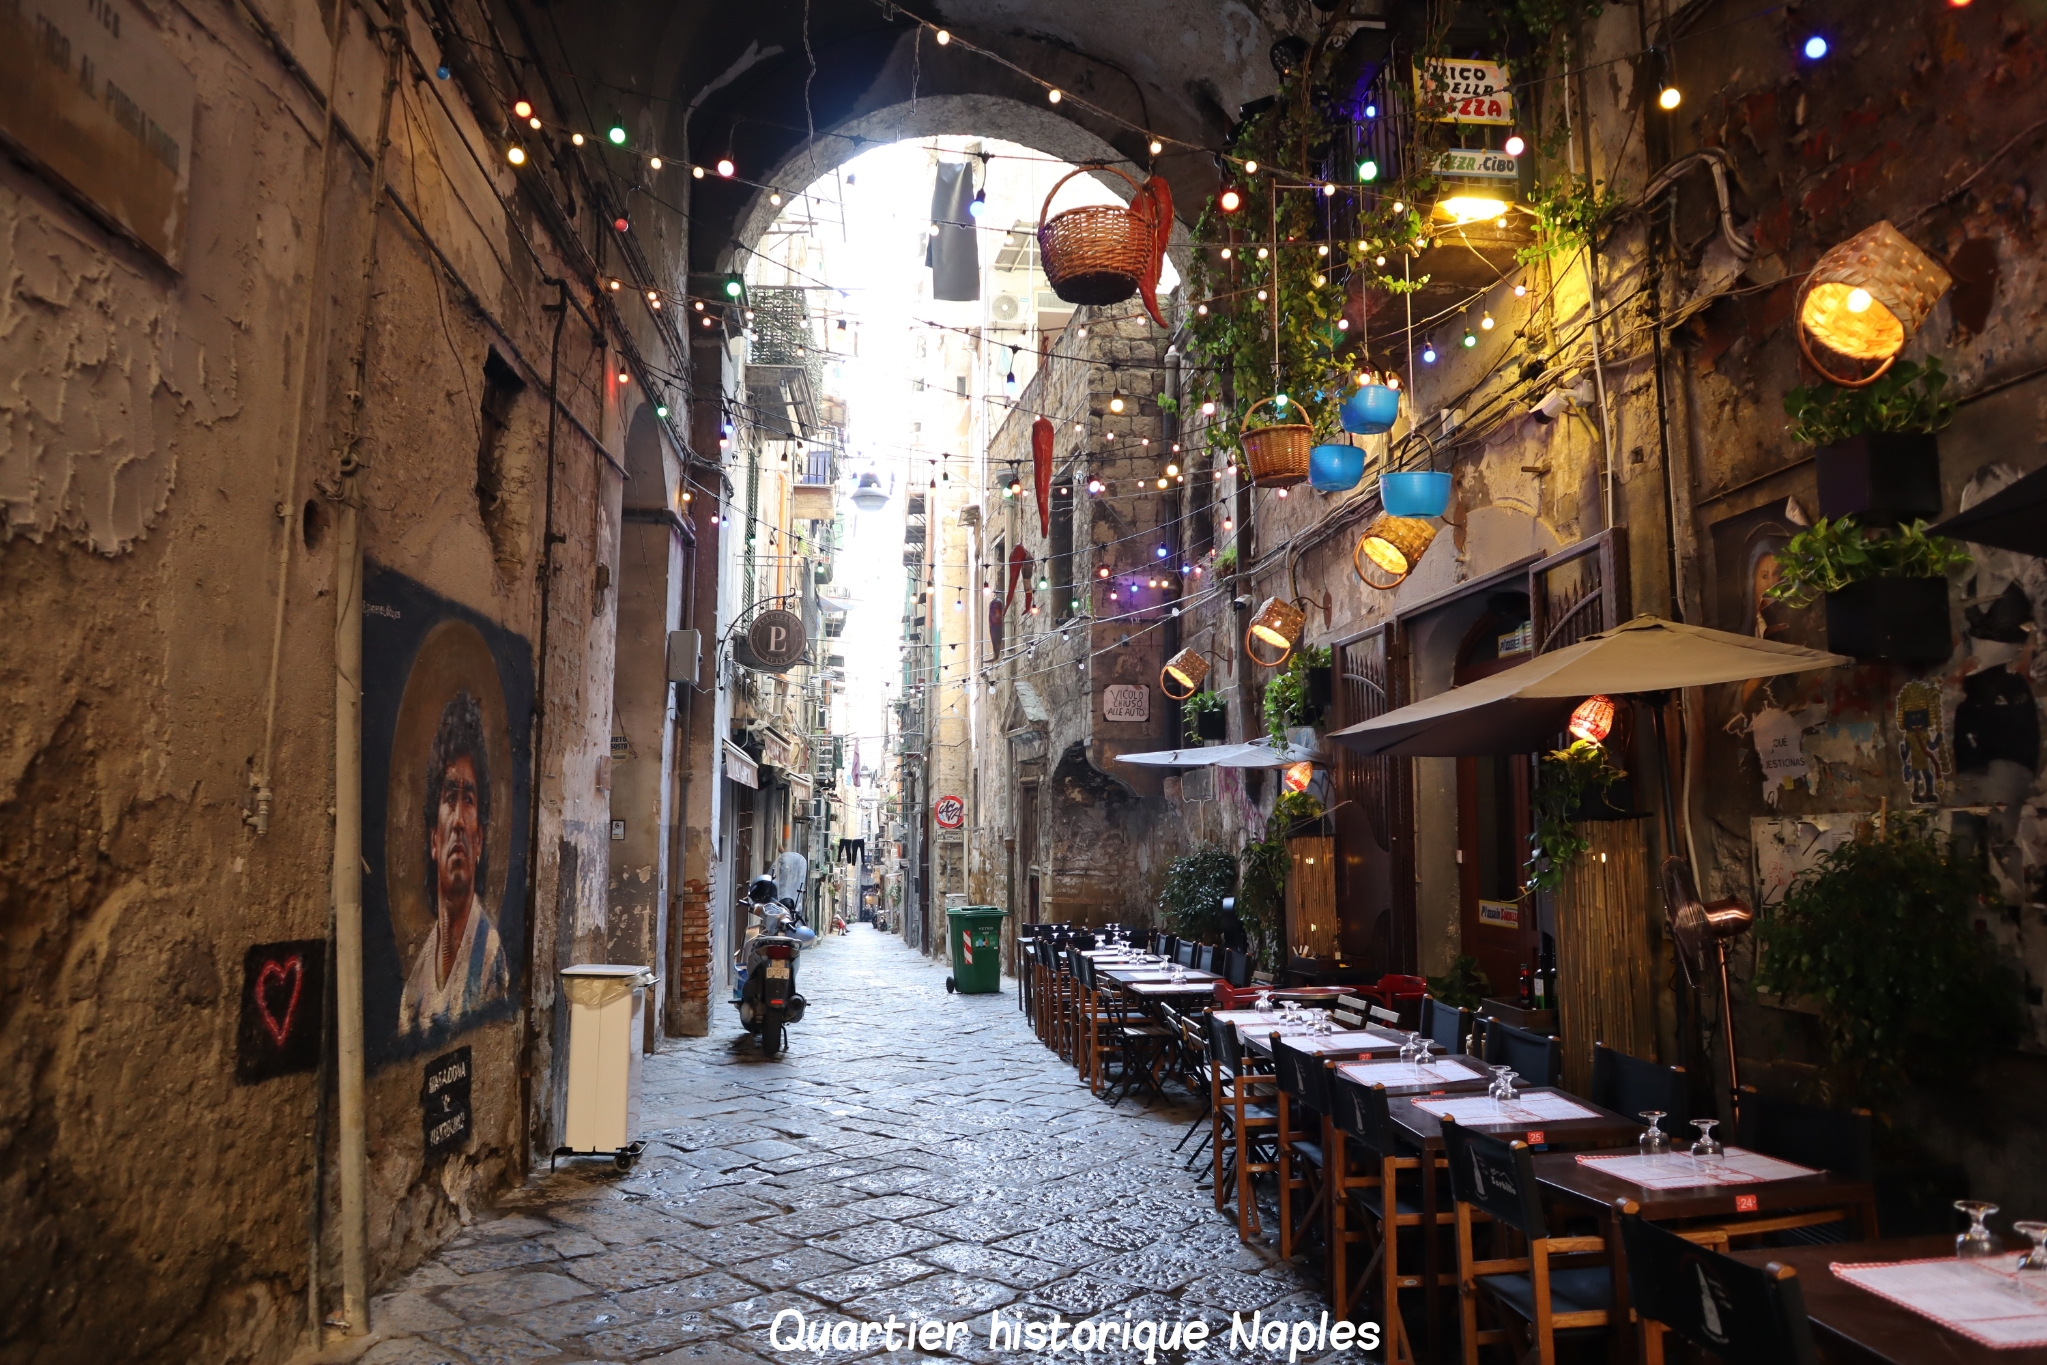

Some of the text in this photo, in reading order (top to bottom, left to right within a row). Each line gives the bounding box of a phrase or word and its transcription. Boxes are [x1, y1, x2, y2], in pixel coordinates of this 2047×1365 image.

[765, 656, 789, 664] SUITE
[1110, 690, 1144, 700] VICOLO
[1113, 699, 1143, 709] CHIUSO
[1107, 707, 1145, 717] ALLE AUTO
[1531, 1133, 1542, 1142] 25
[1740, 1198, 1753, 1209] 24
